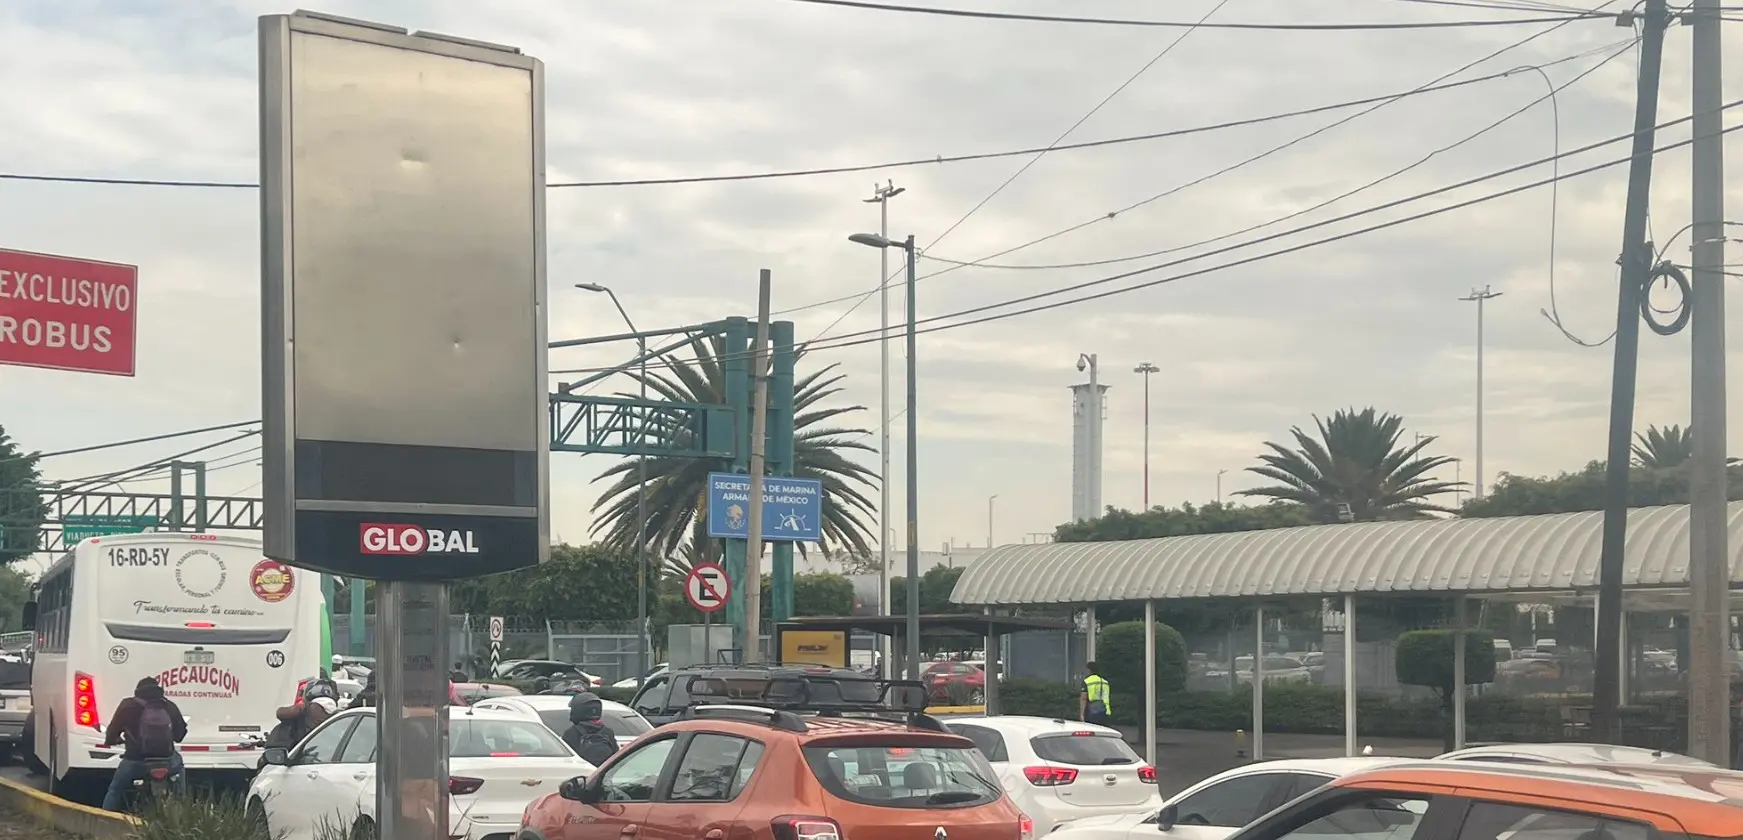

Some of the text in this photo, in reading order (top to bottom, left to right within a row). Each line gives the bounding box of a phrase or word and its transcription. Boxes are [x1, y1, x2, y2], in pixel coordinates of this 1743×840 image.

[0, 269, 130, 311] EXCLUSIVO
[0, 315, 112, 352] ROBUS
[714, 481, 816, 495] SECRETAA DE MARINA
[722, 492, 749, 502] ARMA
[762, 494, 773, 503] DE
[363, 527, 479, 553] GLOBAL
[108, 548, 169, 567] 16-RD-5Y
[255, 573, 291, 585] ACME
[112, 648, 126, 657] 95
[269, 652, 283, 665] 006
[165, 690, 232, 699] ARADAS CONTINUAS
